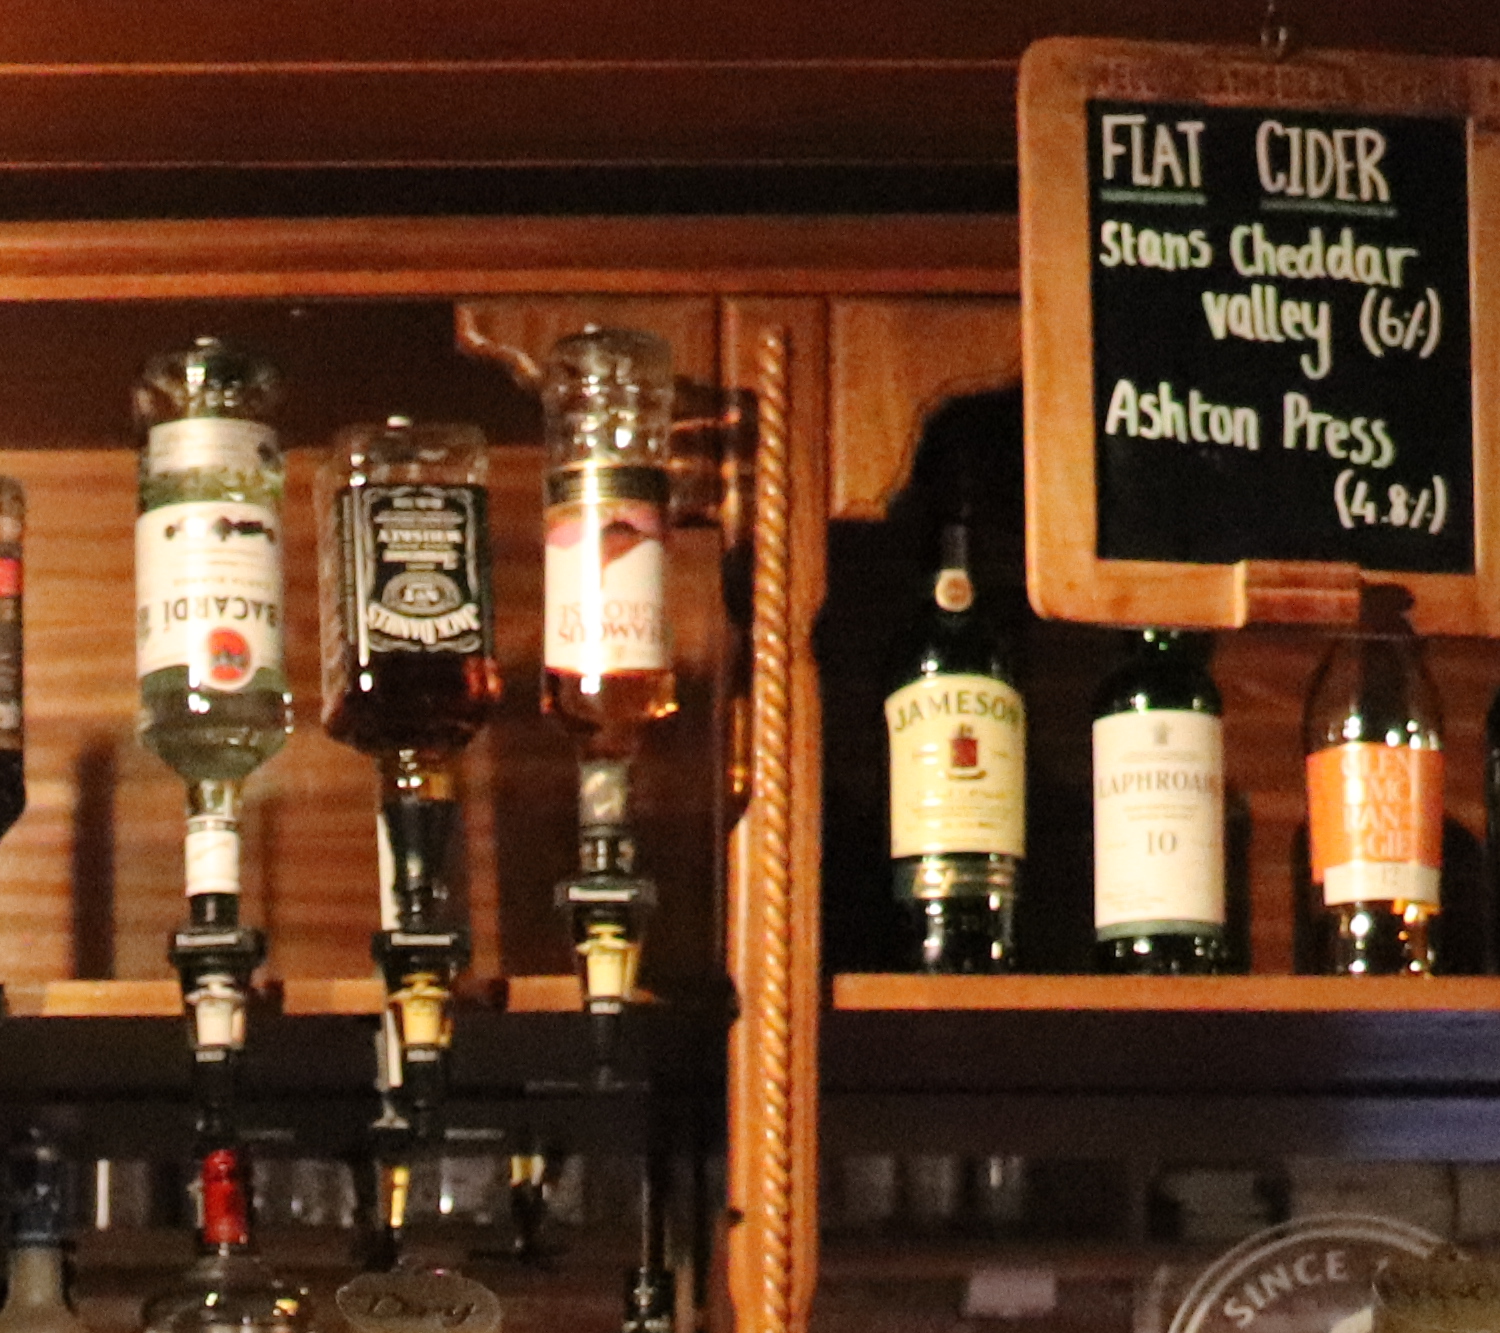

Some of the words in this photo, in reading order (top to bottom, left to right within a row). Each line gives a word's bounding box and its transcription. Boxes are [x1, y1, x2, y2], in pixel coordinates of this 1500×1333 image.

[1102, 114, 1204, 187] FLAT
[1256, 119, 1391, 202] CIDER
[1230, 223, 1418, 287] Cheddar
[1105, 379, 1258, 451] Ashton
[1283, 391, 1395, 468] Press
[895, 689, 1020, 732] JAMESON
[1146, 829, 1178, 856] 10
[1223, 1250, 1350, 1329] SINCE
